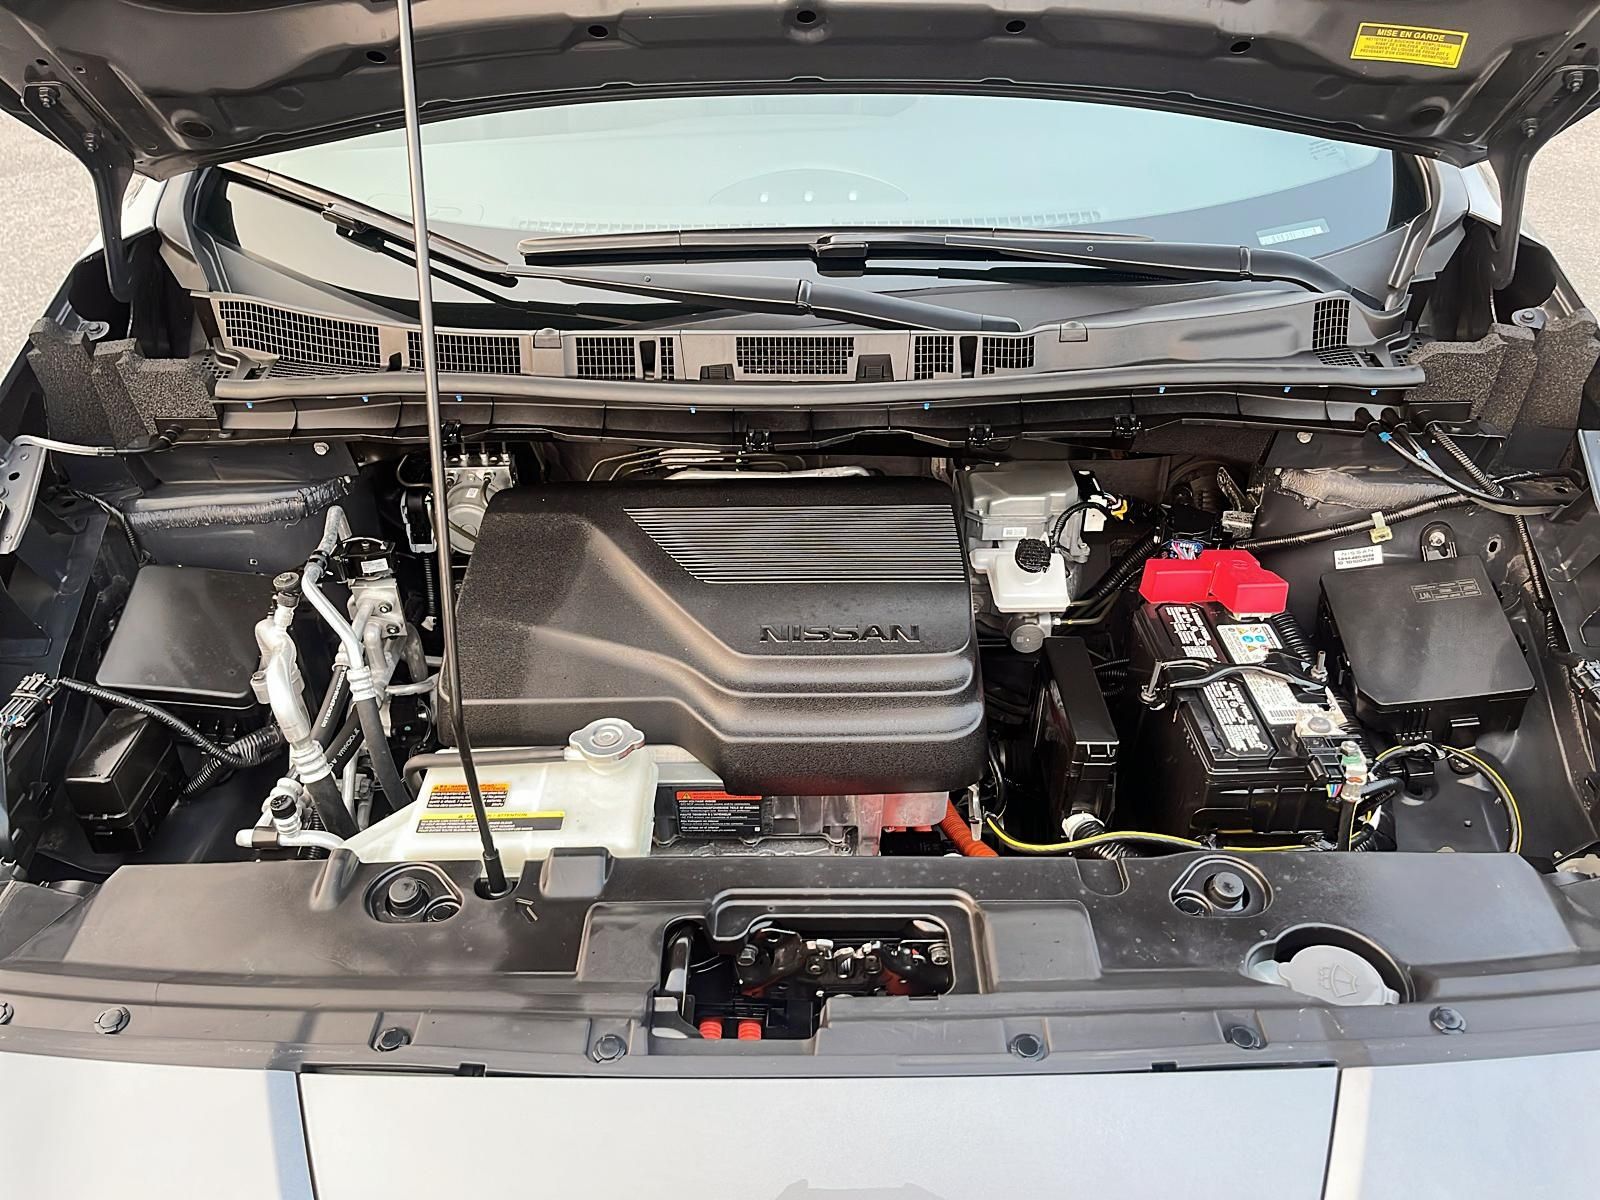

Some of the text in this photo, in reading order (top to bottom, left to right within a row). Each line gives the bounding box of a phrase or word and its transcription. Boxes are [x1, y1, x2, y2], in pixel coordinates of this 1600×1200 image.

[1376, 28, 1446, 41] MISE EN GARDE
[759, 624, 920, 643] NISSAN
